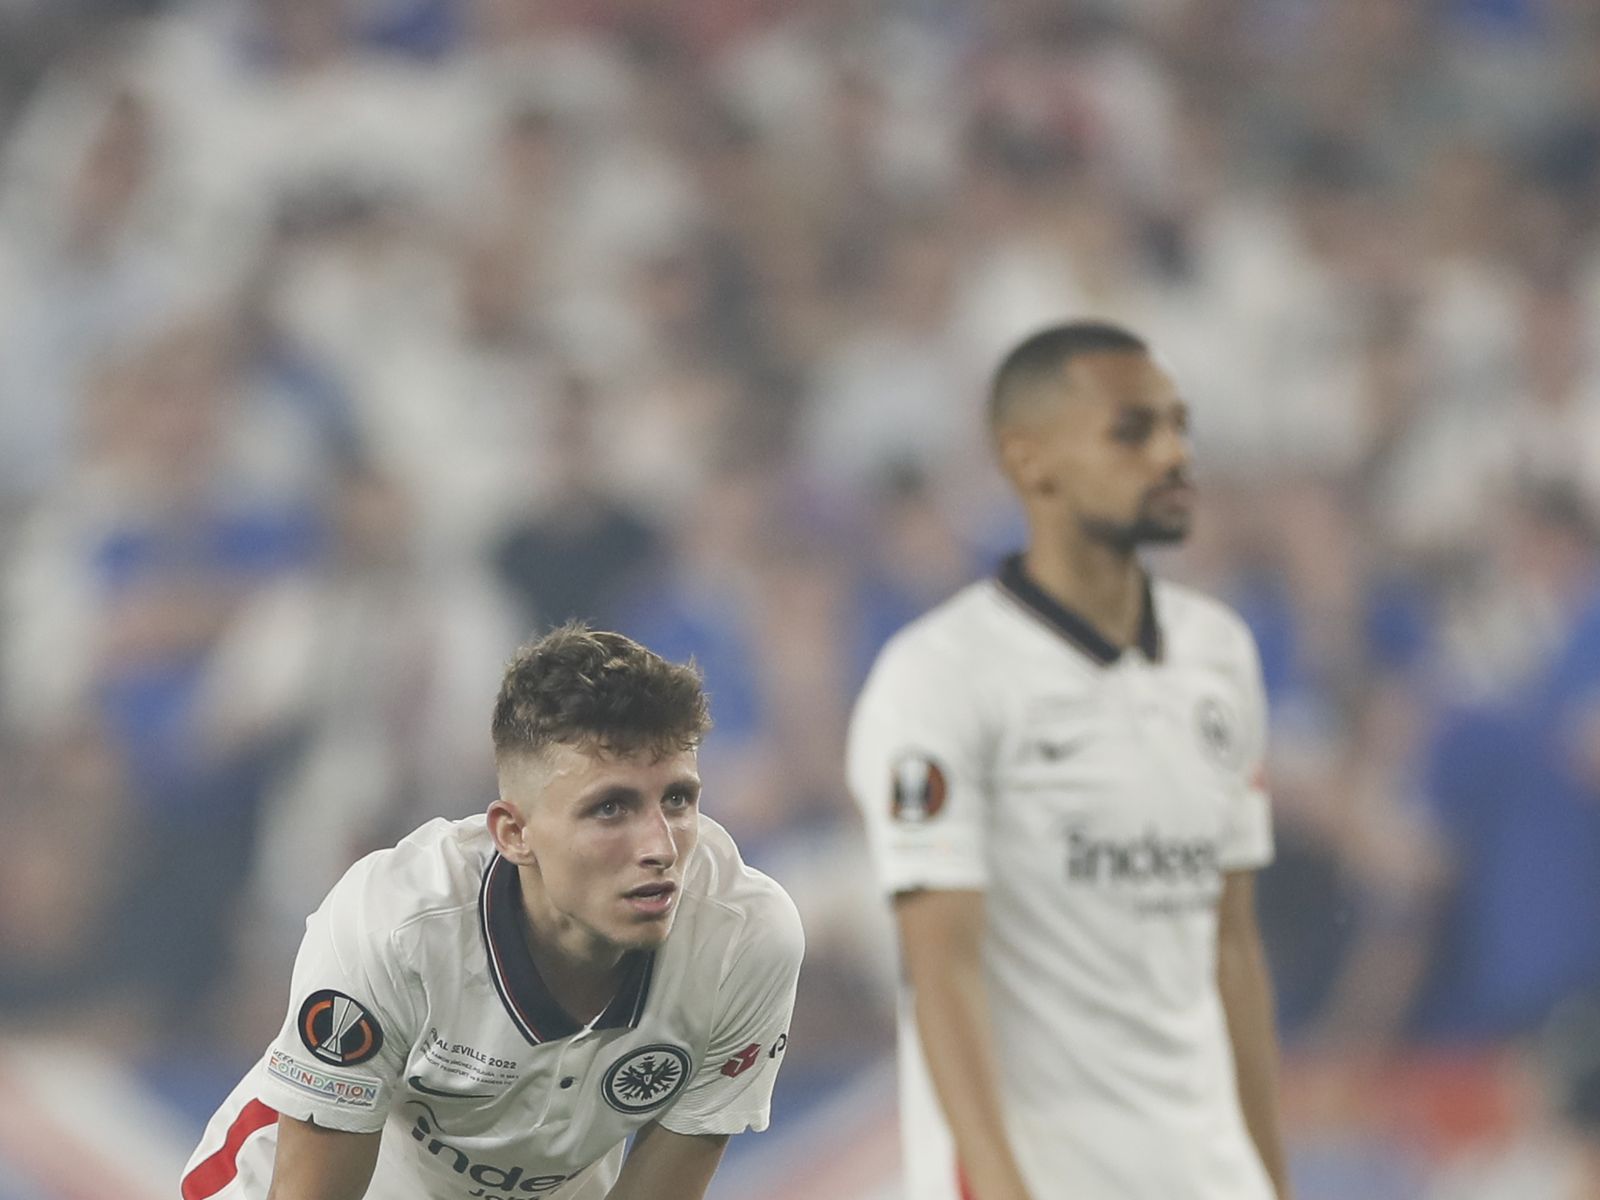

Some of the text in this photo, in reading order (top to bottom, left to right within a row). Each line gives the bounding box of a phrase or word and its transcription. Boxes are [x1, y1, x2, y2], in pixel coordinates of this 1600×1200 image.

[270, 1055, 377, 1100] FOUNDATION
[451, 1044, 487, 1064] SEVILLE
[488, 1057, 518, 1070] 2022
[411, 1102, 585, 1192] inde
